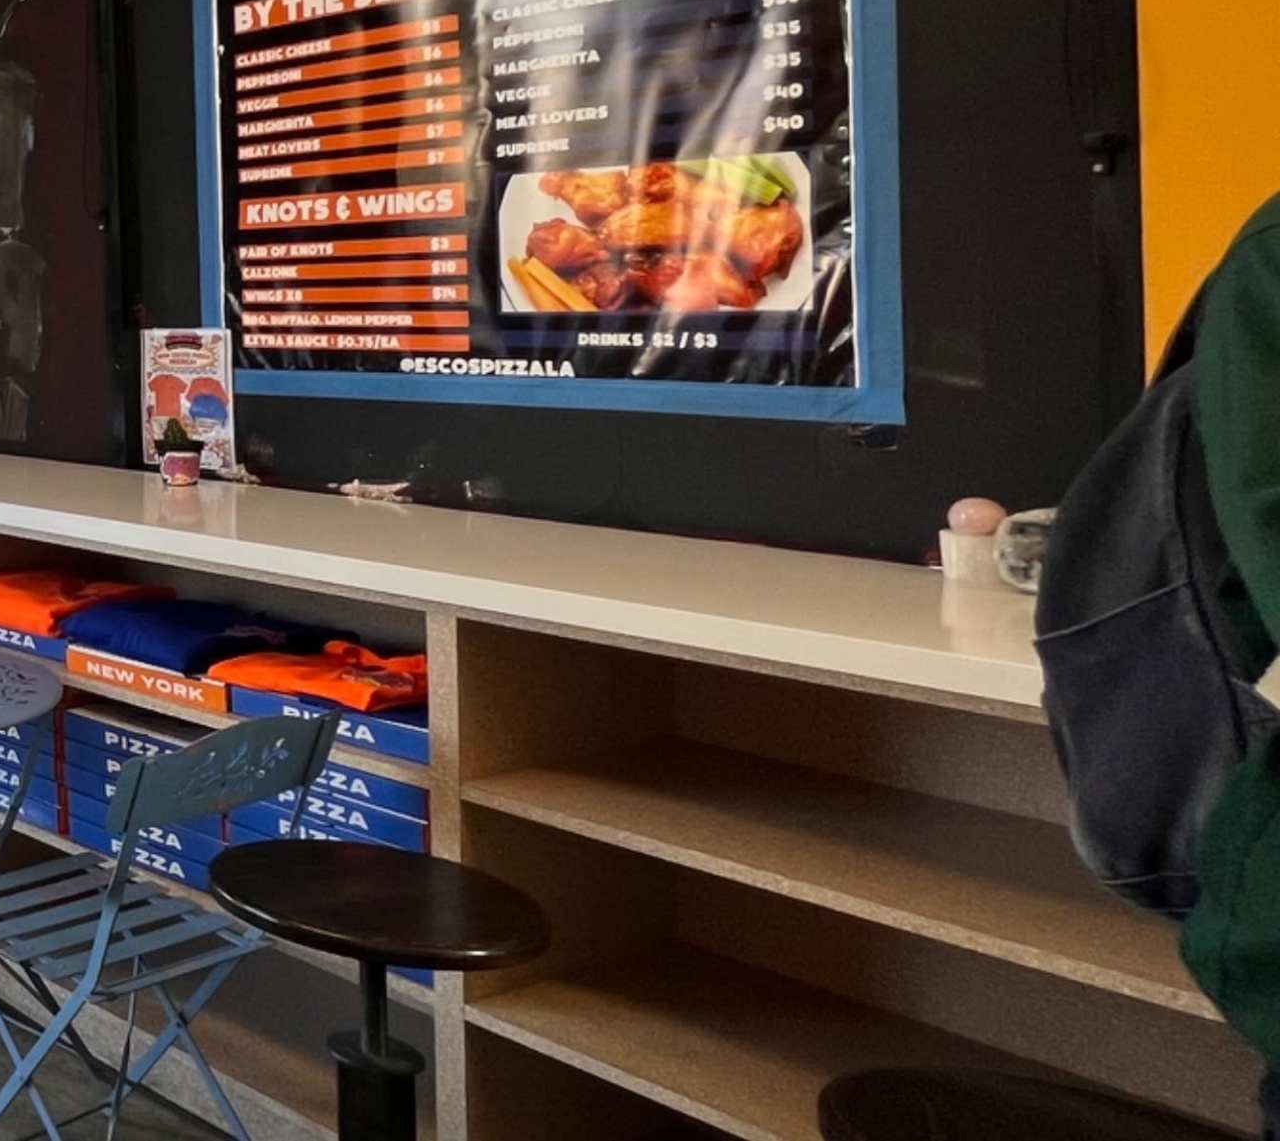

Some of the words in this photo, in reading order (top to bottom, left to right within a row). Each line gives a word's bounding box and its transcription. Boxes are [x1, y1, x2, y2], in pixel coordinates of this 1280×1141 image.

[234, 0, 275, 34] BY
[492, 1, 558, 22] CLASSIC
[493, 24, 584, 50] PEPPERONI
[762, 20, 801, 39] $35
[236, 47, 284, 68] CLASSIC
[285, 39, 332, 60] CHEESE
[494, 49, 600, 76] MARGHERITA
[763, 52, 801, 71] $35
[237, 69, 302, 90] PEPPERONI
[495, 84, 552, 103] VEGGIE
[764, 82, 803, 102] $40
[238, 96, 279, 113] VEGGIE
[238, 116, 314, 137] MARGHERITA
[496, 114, 537, 131] MEAT
[540, 105, 608, 125] LOVERS
[764, 114, 804, 133] $40
[238, 145, 270, 160] MEAT
[271, 138, 321, 156] LOVERS
[496, 138, 570, 158] SUPREME
[239, 166, 293, 183] SUPREME
[247, 198, 329, 224] KNOTS
[336, 195, 351, 220] &
[357, 188, 453, 216] WINGS
[240, 244, 270, 258] PAIR
[270, 244, 287, 257] OF
[290, 242, 333, 256] KNOTS
[241, 265, 298, 279] CALZONE
[243, 289, 283, 302] WINGS
[364, 314, 413, 326] PEPPER
[244, 333, 283, 347] EXTRA
[285, 334, 328, 347] SAUCE
[577, 332, 644, 347] DRINKS
[652, 332, 675, 348] $2
[693, 332, 718, 348] $3
[400, 357, 575, 379] @ESCOSPIZZALA
[86, 660, 134, 685] NEW
[141, 674, 205, 703] YORK
[277, 789, 369, 830] PZZA
[110, 838, 185, 879] PZZA
